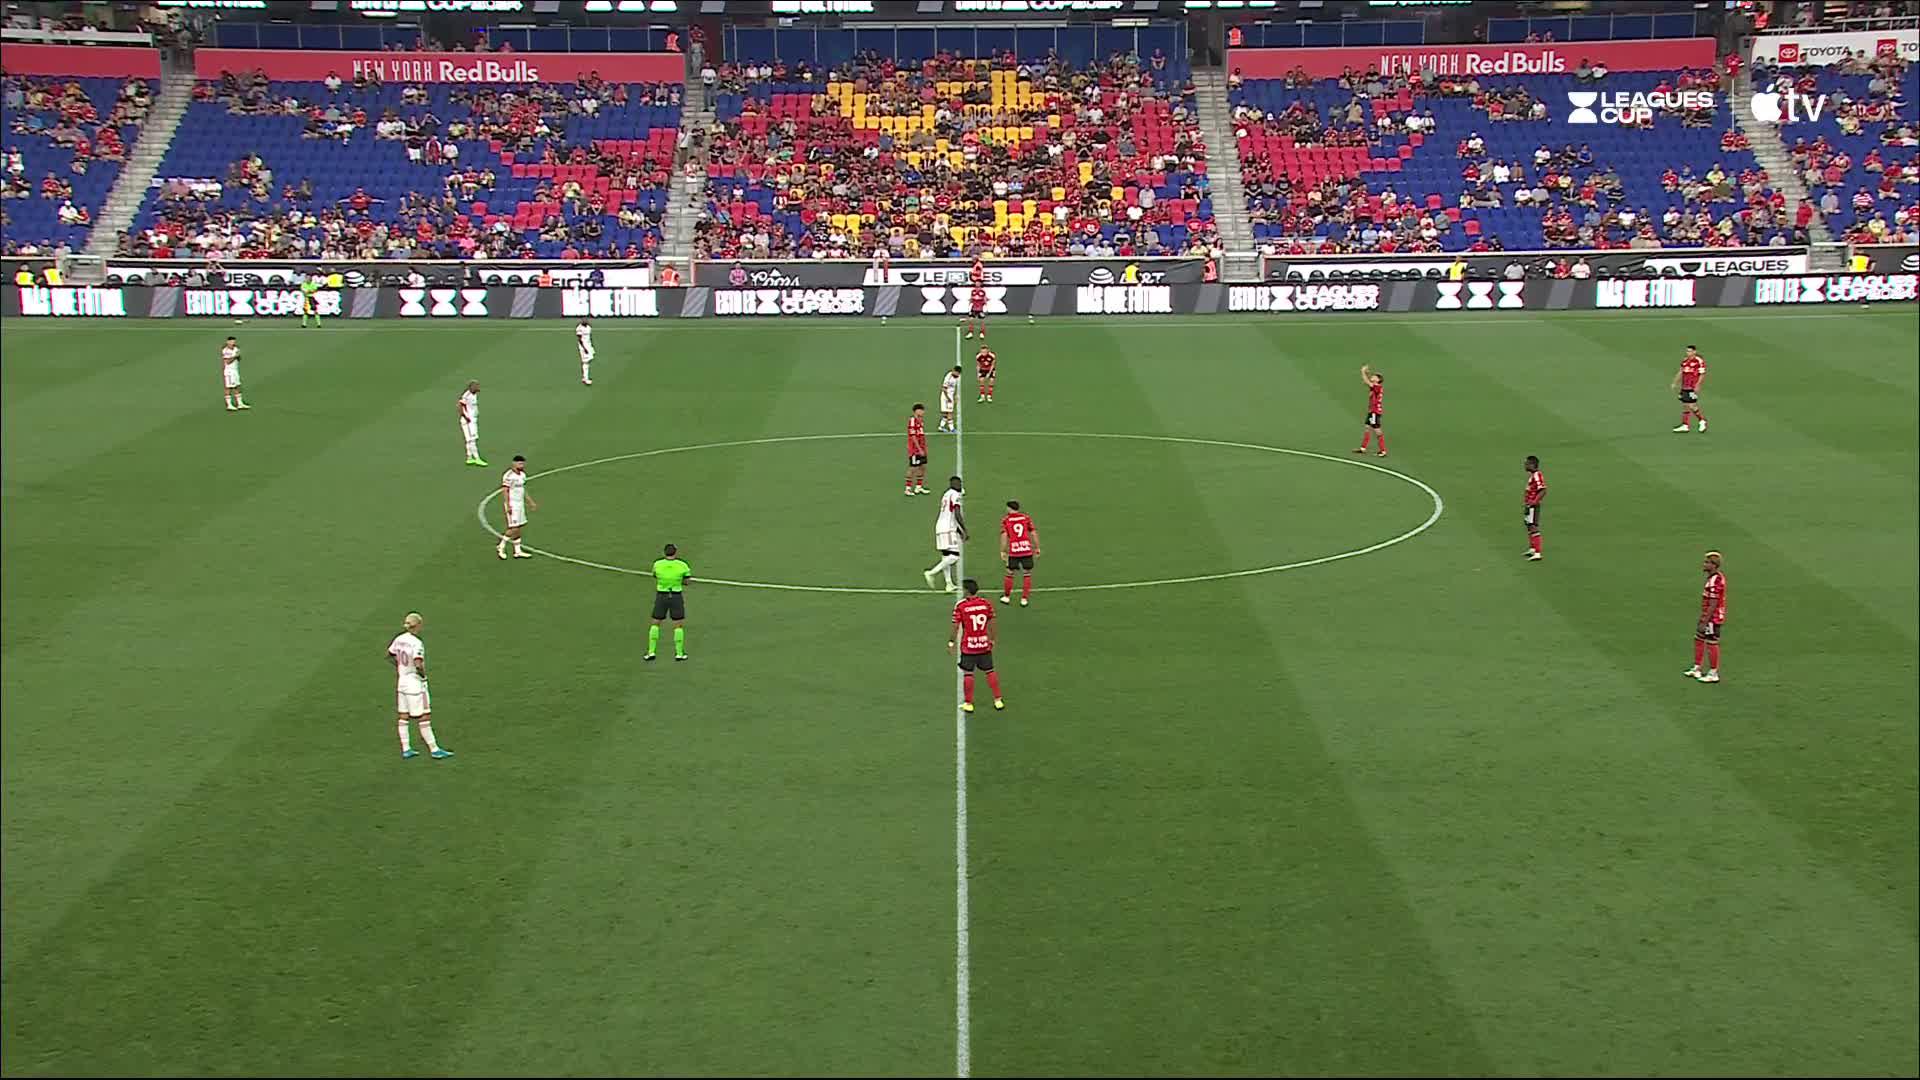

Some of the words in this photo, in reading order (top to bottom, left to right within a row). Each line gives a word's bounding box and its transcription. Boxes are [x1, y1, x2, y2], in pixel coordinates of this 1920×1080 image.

[391, 60, 432, 81] YORK
[439, 60, 482, 82] Red
[485, 60, 539, 82] Bulls
[1419, 53, 1459, 76] YORK
[1466, 51, 1509, 75] Red
[1511, 50, 1566, 74] Bulls
[1704, 260, 1789, 273] LEAGUES
[1013, 523, 1024, 538] 9
[969, 613, 988, 631] 19
